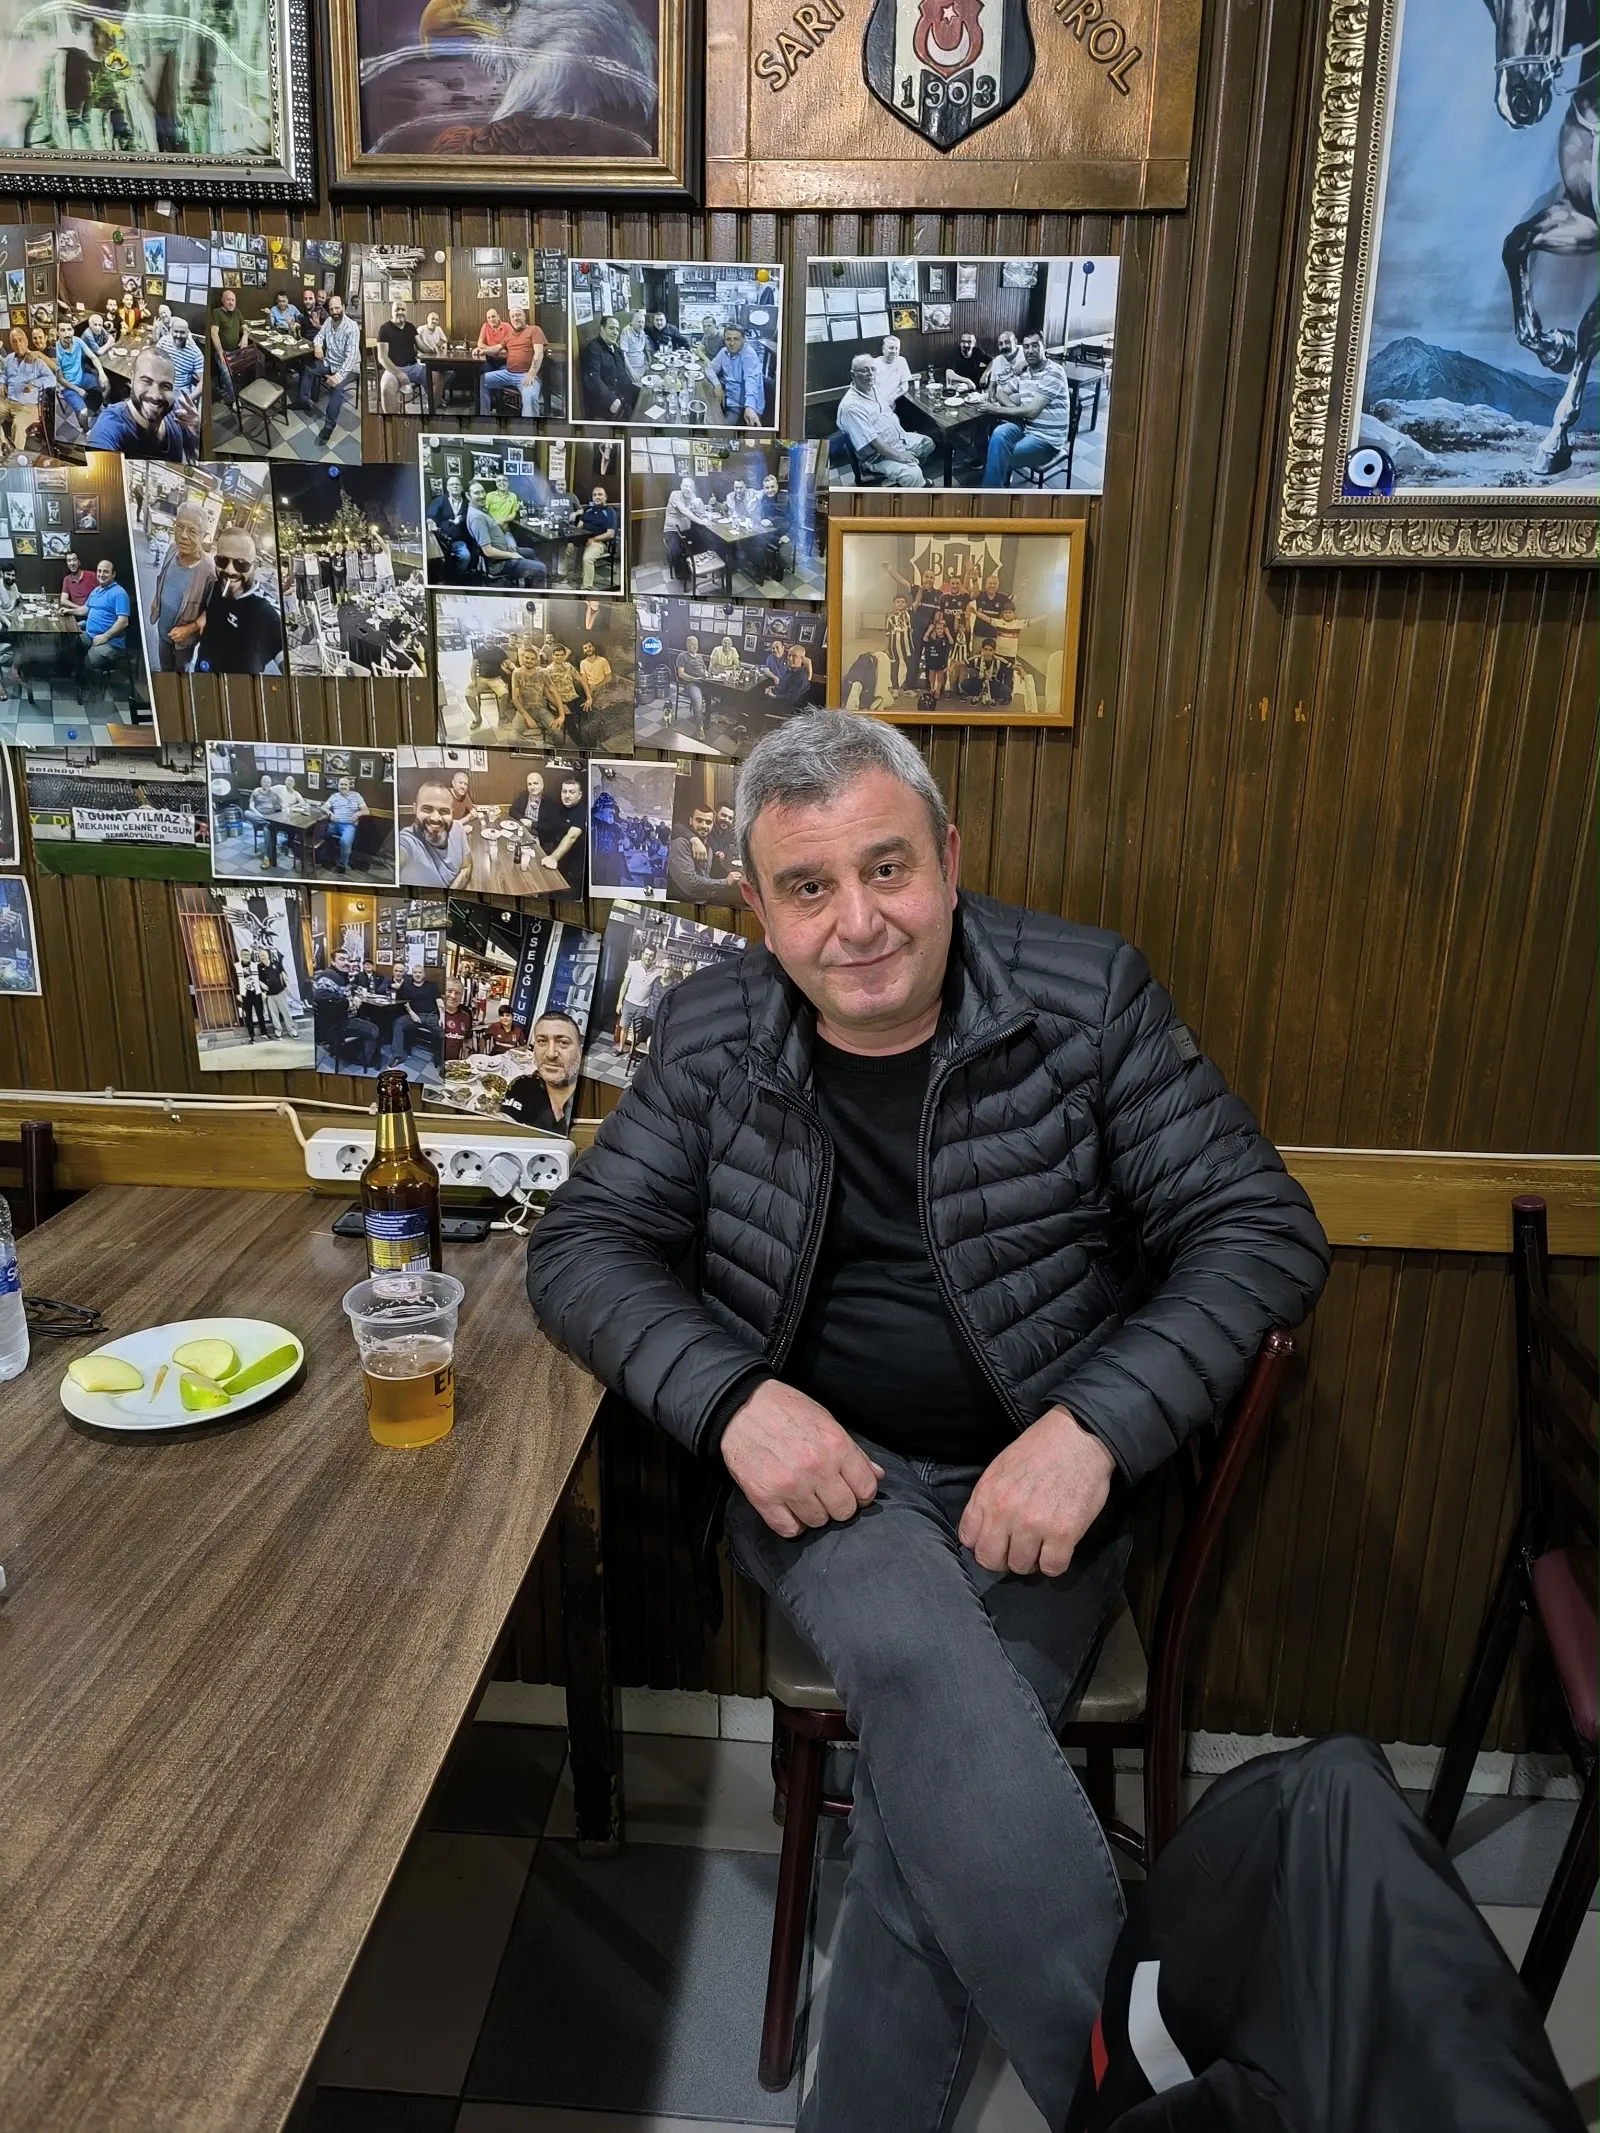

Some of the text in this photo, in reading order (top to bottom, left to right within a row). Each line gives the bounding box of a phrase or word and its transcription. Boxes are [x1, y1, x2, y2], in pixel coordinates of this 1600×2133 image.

[901, 75, 996, 109] 1903
[87, 810, 180, 824] GÜNAY YILMAZ
[77, 822, 192, 835] MEKANIN CENNET OLSUN
